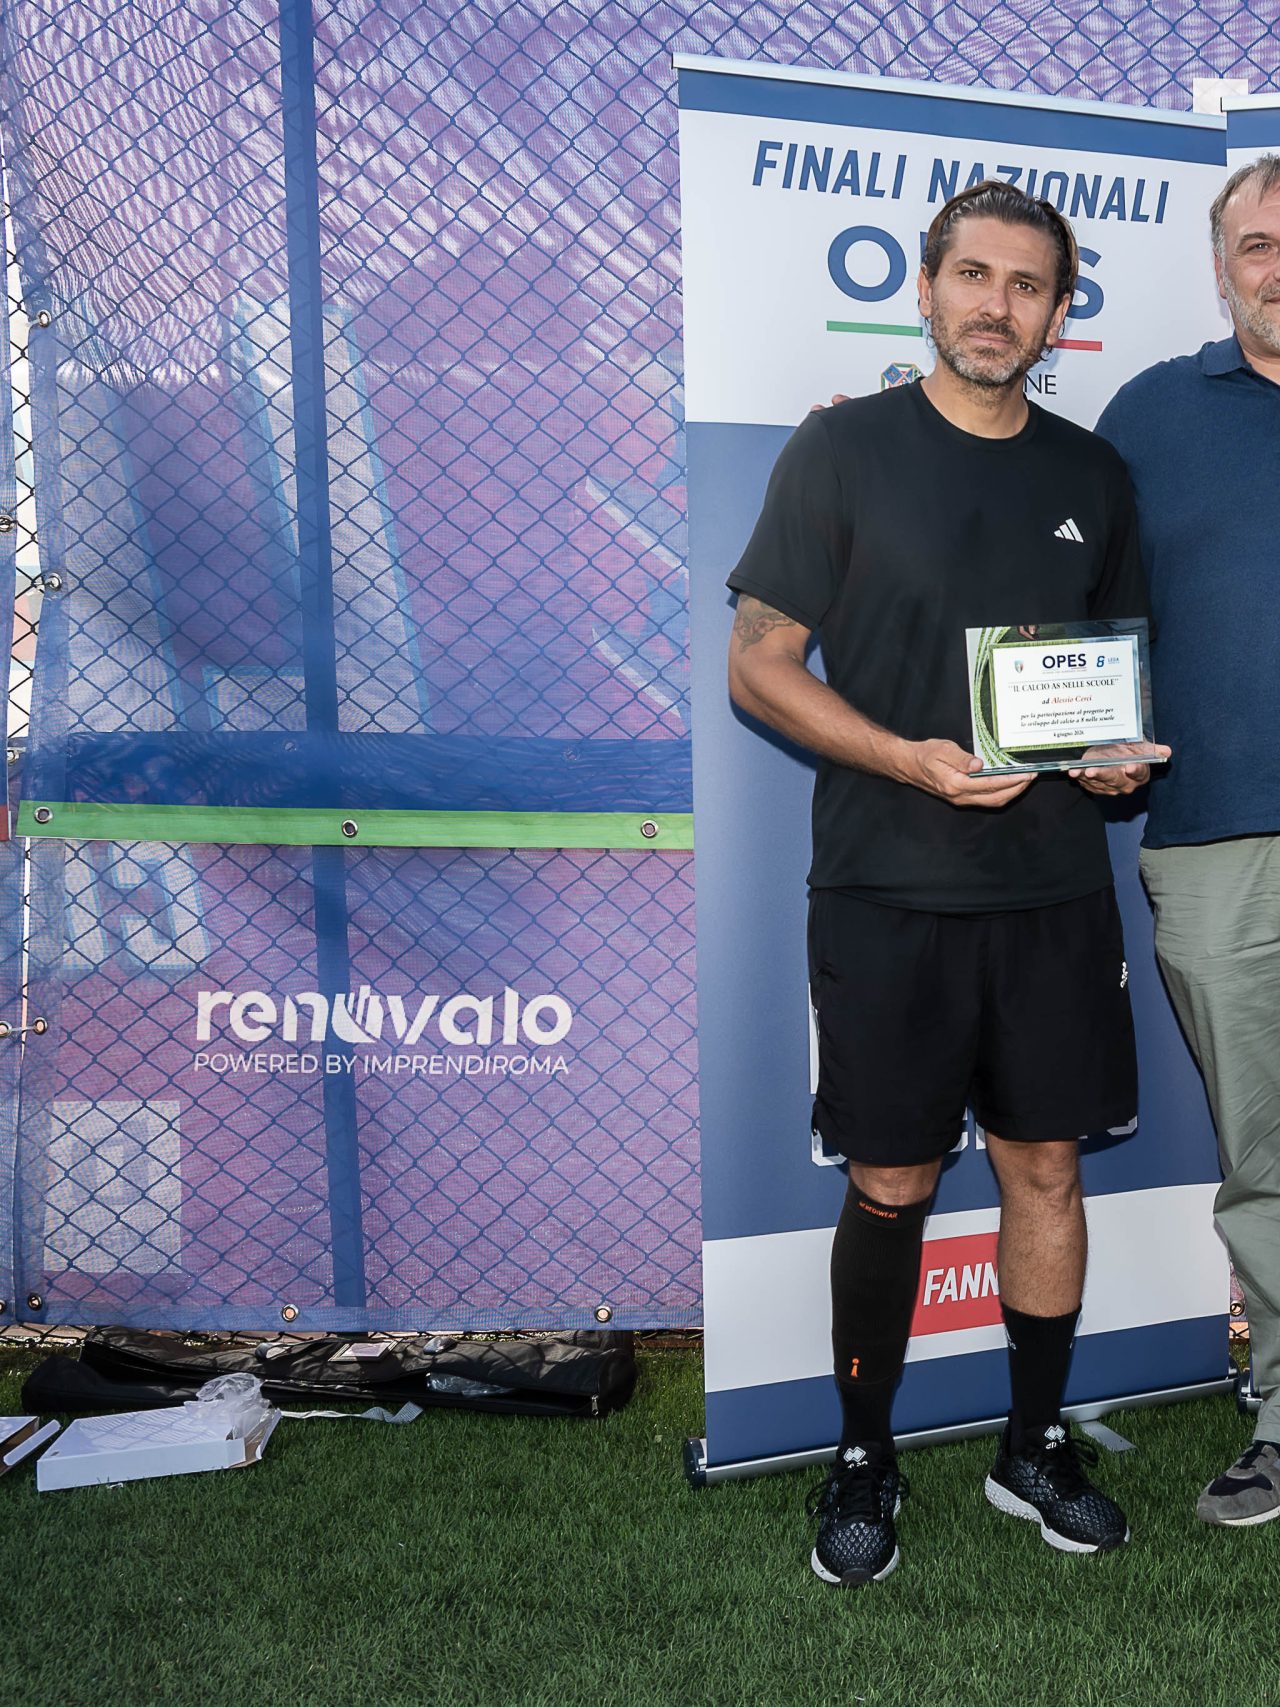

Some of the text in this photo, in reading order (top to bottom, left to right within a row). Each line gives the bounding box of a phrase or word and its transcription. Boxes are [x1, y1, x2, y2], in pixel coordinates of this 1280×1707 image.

[752, 140, 907, 200] FINALI
[1042, 653, 1087, 669] OPES
[1021, 682, 1050, 692] CALCIO
[1062, 679, 1085, 689] NELLE
[193, 1053, 571, 1077] POWERED BY IMPRENDIROMA
[923, 1262, 1000, 1306] FANN
